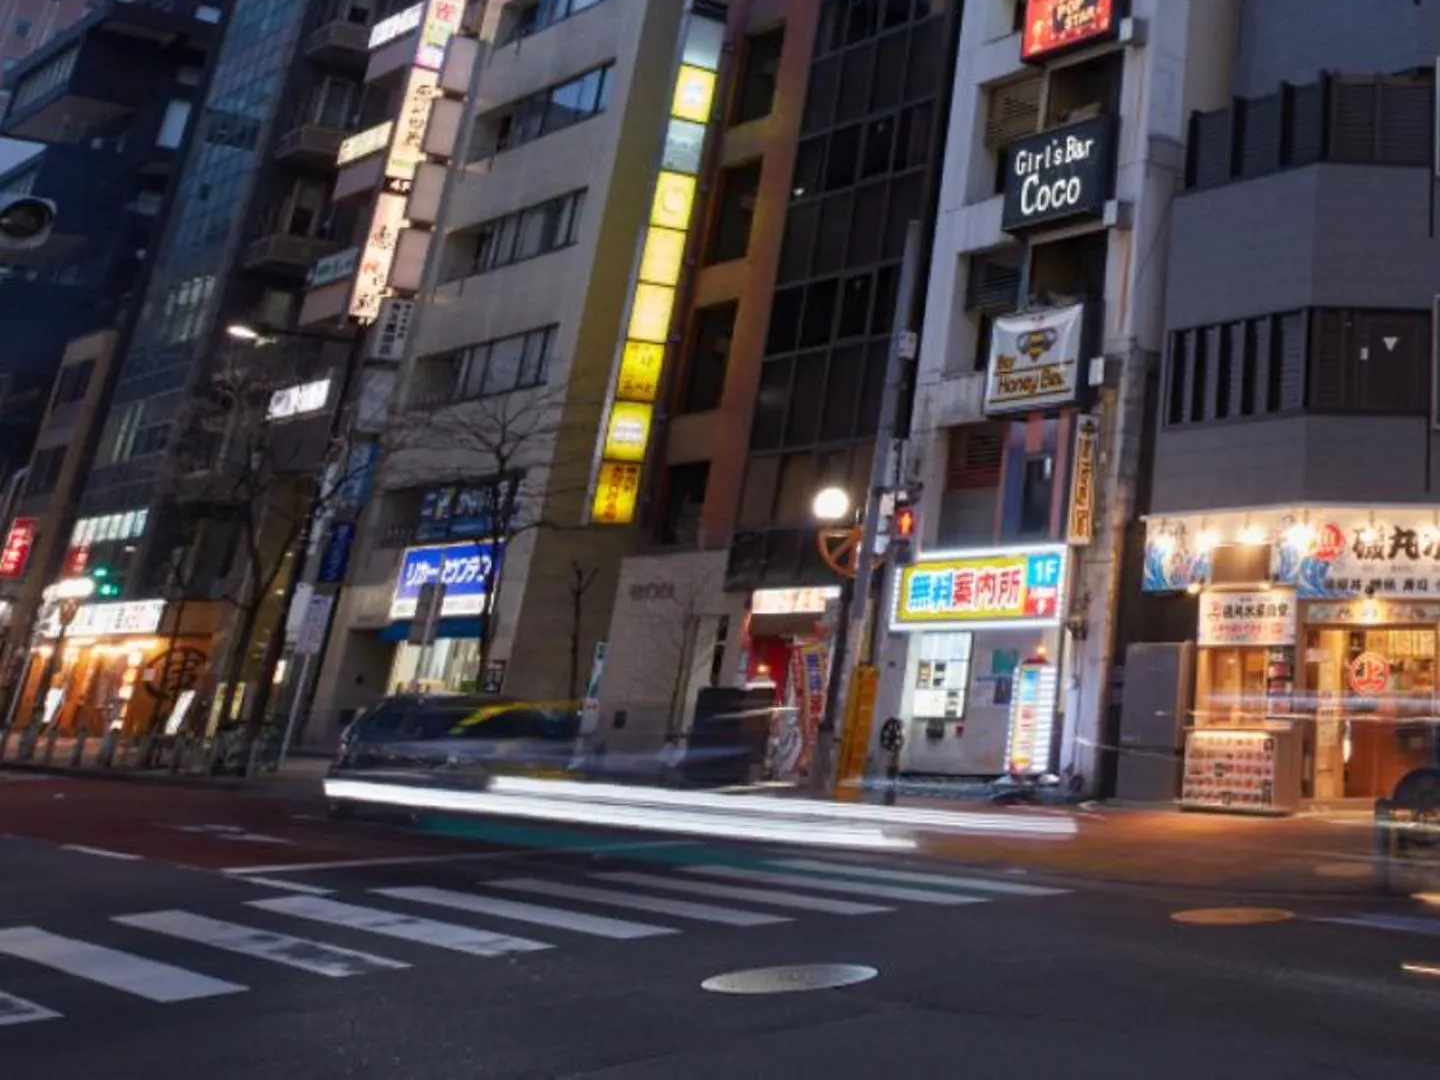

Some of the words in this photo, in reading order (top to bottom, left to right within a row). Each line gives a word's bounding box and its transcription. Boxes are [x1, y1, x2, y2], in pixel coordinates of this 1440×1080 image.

[1015, 138, 1063, 176] Girl's
[1065, 133, 1094, 164] Bar
[1020, 173, 1082, 216] Coco
[909, 569, 1021, 609] 無料案内所
[1034, 559, 1058, 583] 1F
